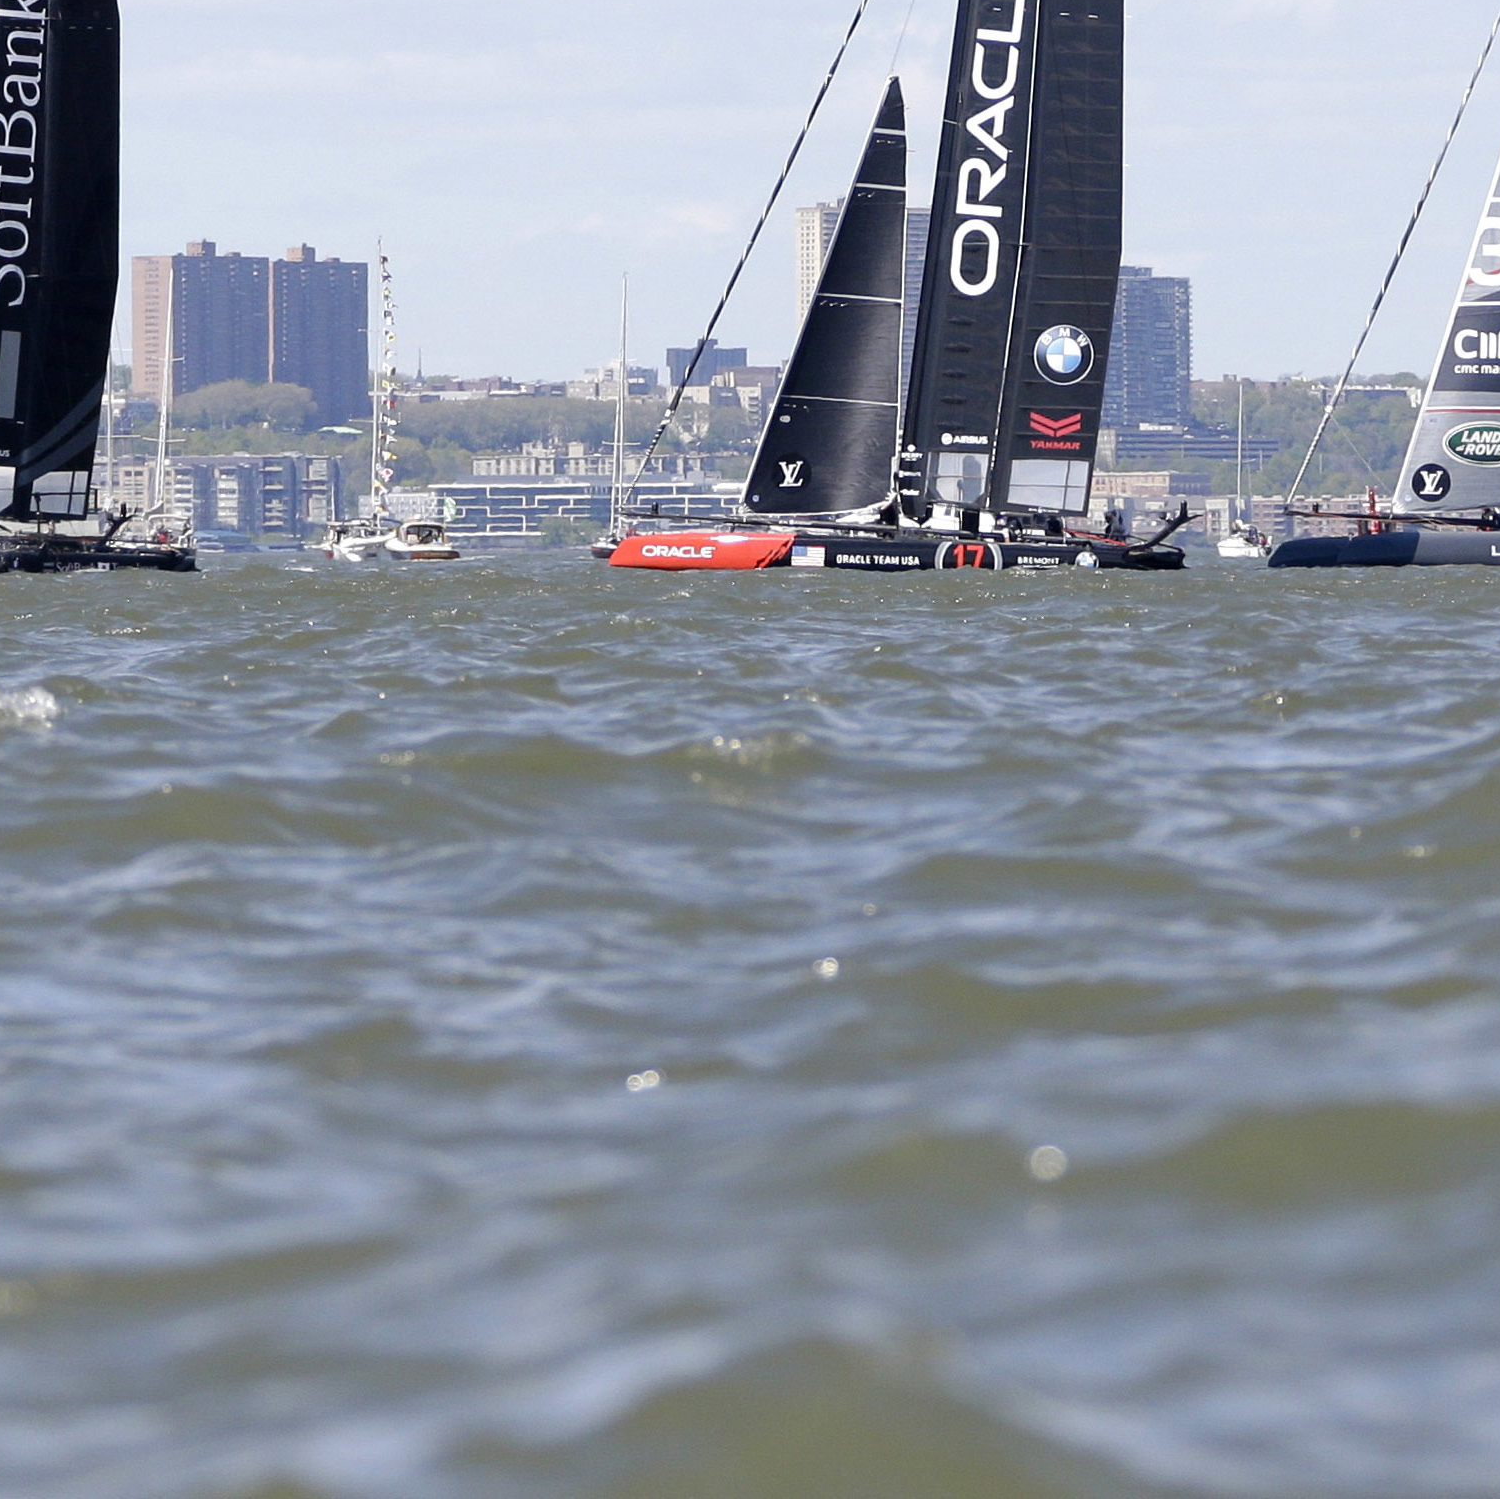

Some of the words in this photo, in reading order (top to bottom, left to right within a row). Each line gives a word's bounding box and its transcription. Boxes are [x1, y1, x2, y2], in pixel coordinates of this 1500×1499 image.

[1040, 327, 1089, 348] BMW
[1454, 364, 1480, 374] cmc
[953, 435, 989, 445] AIRBUS
[1030, 440, 1081, 450] YANMAR
[642, 545, 714, 558] ORACLE
[953, 544, 985, 568] 17
[836, 554, 871, 564] ORACLE
[873, 555, 899, 565] TEAM
[901, 555, 920, 566] USA
[1017, 556, 1060, 564] BREMONT
